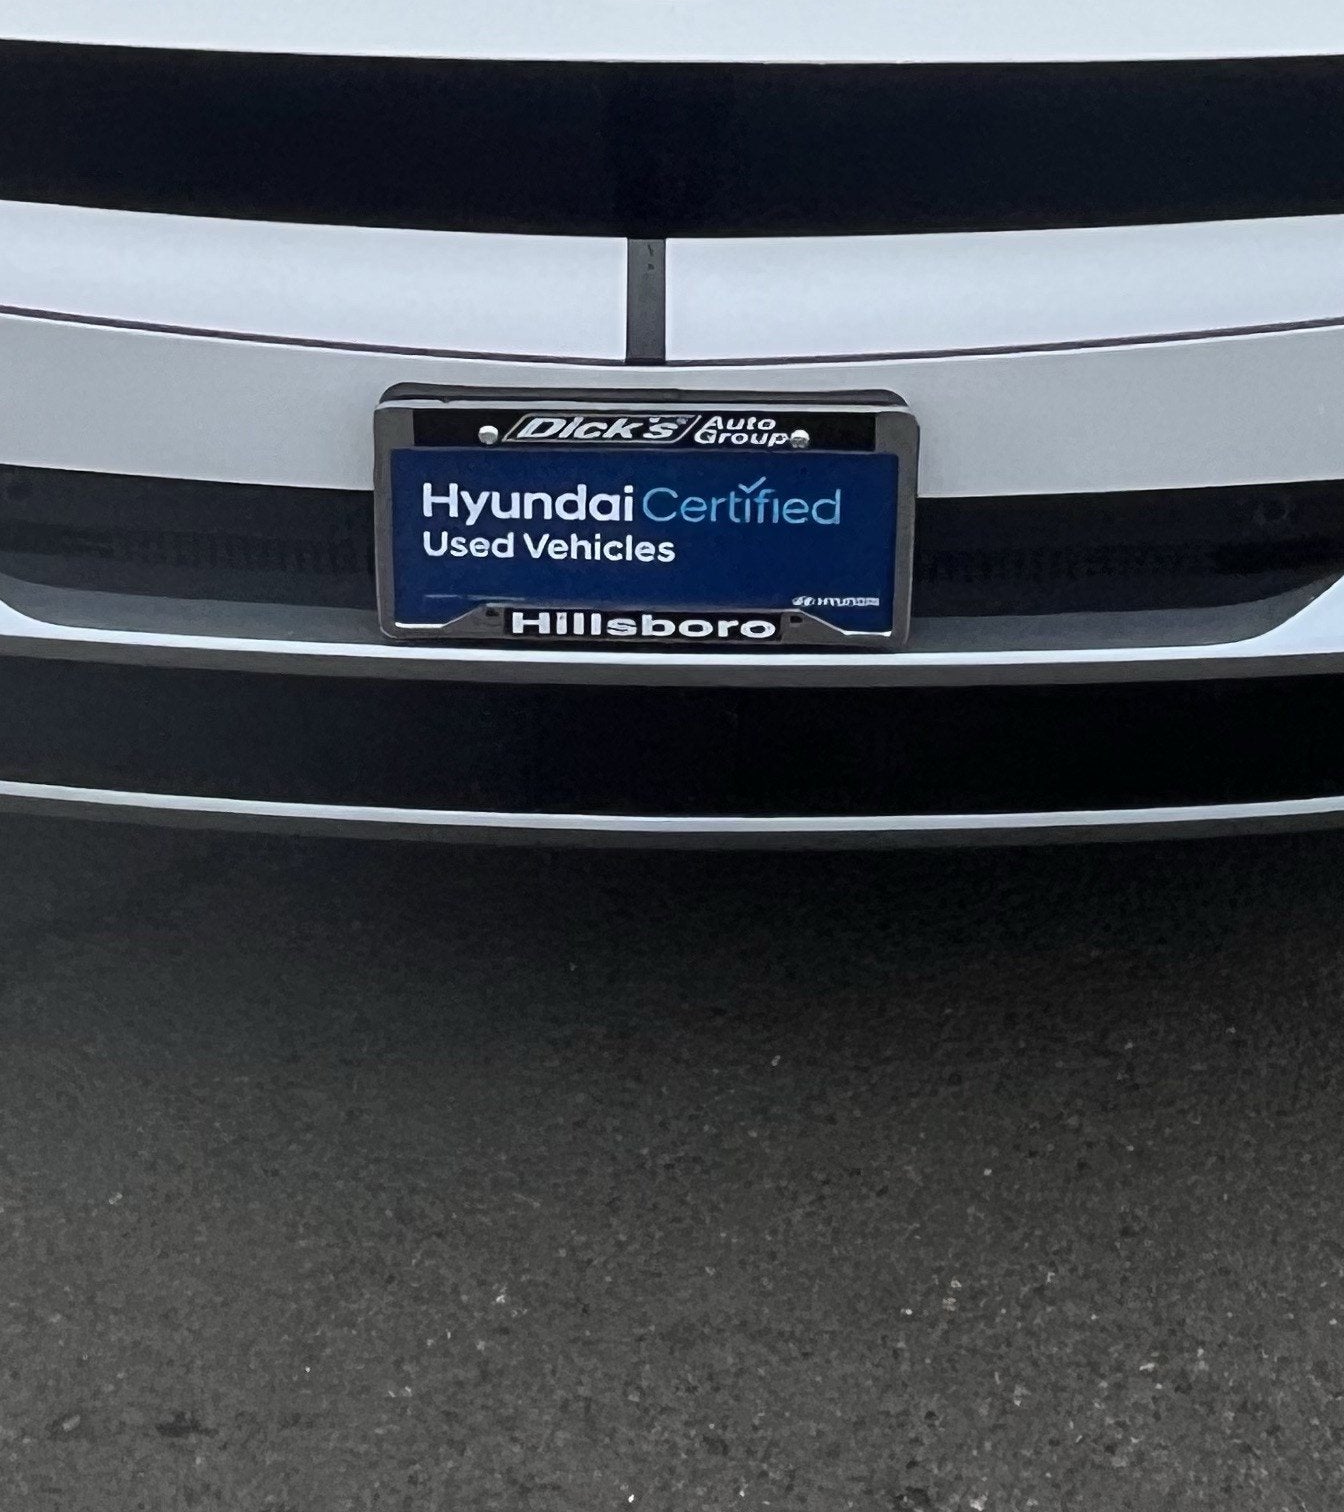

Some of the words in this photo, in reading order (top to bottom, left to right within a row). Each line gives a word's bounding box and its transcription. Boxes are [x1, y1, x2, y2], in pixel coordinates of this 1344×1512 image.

[516, 416, 679, 440] Dick's
[706, 415, 777, 431] Auto
[694, 429, 790, 447] Group
[422, 482, 634, 526] Hyundai
[643, 478, 842, 526] Certified
[422, 531, 515, 559] Used
[523, 531, 676, 563] Vehicles
[511, 609, 777, 640] Hillsboro
